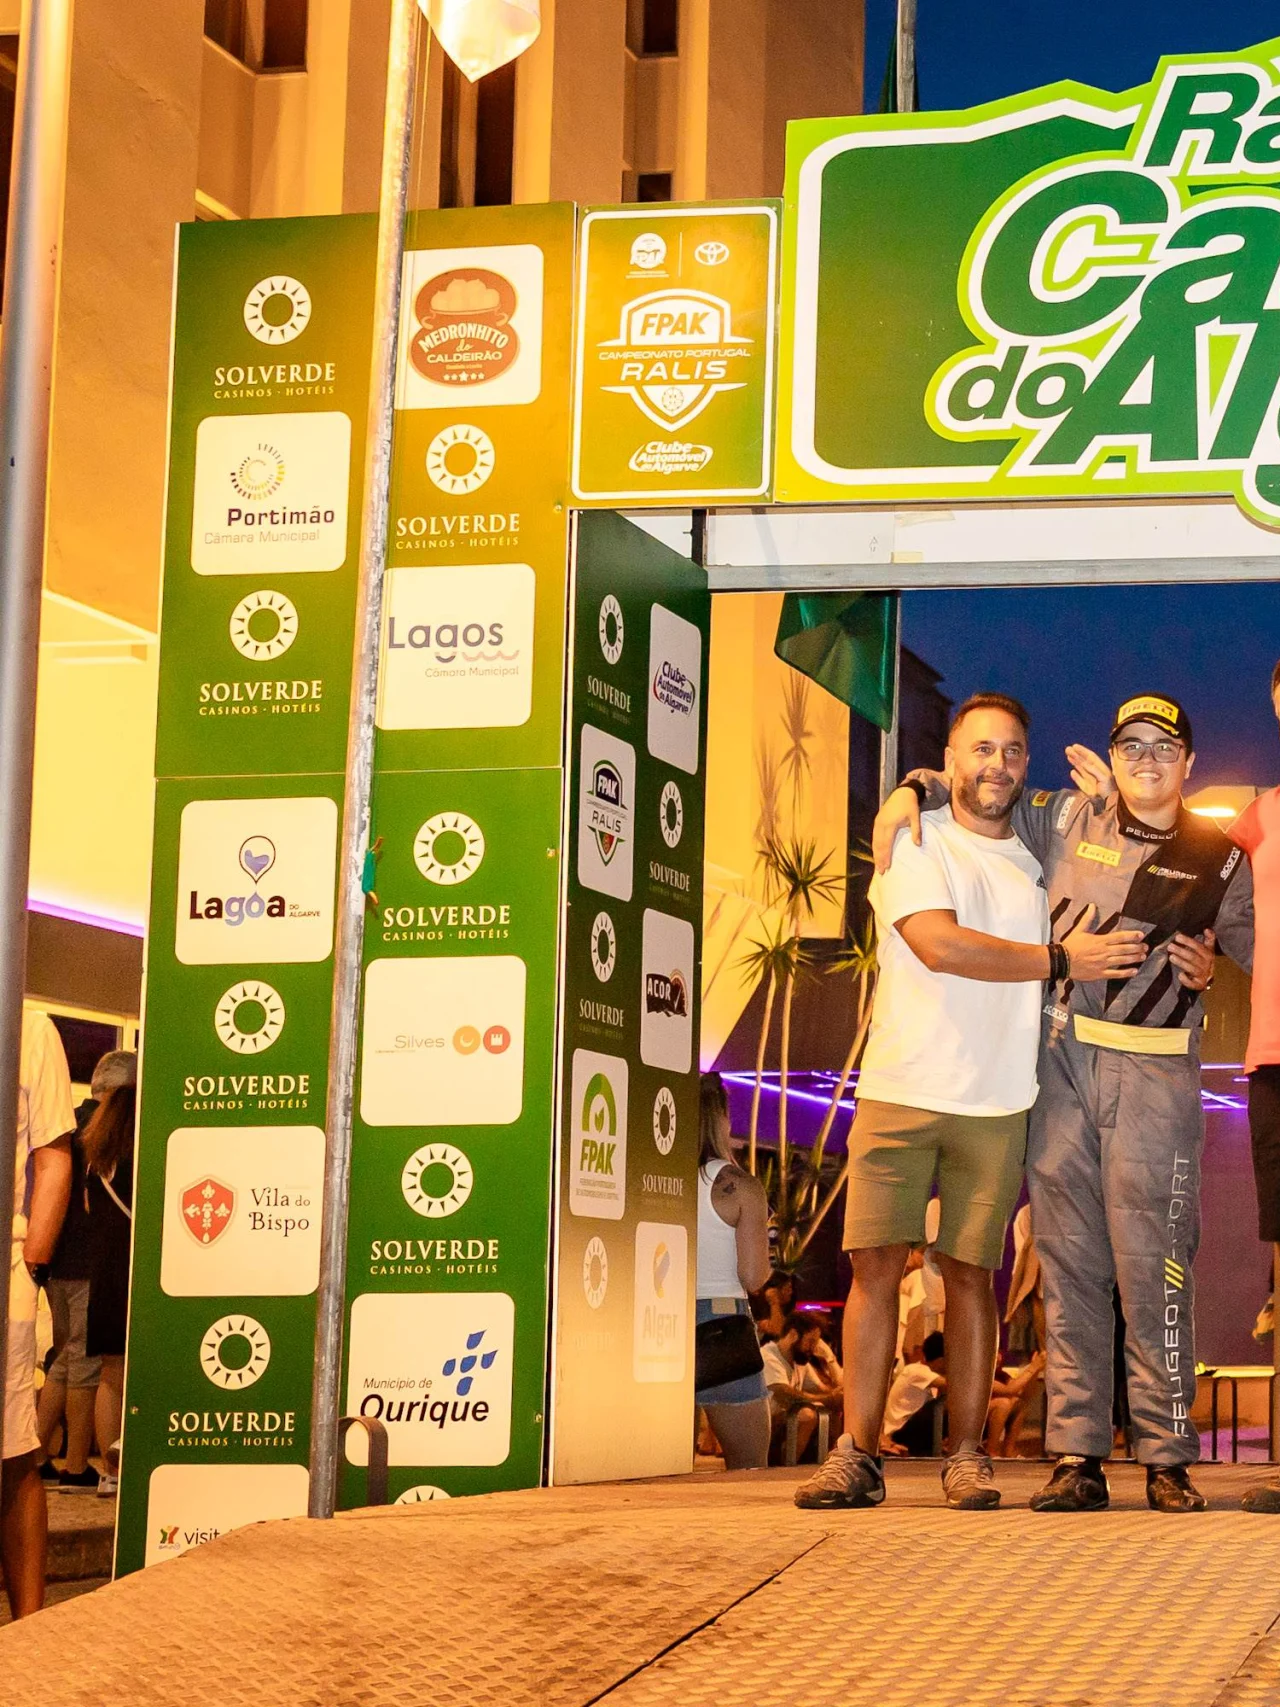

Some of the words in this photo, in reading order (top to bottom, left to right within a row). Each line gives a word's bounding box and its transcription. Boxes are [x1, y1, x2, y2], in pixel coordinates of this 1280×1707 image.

[639, 311, 711, 336] FPAK
[418, 322, 510, 353] MEDRONHITO
[426, 350, 503, 363] CALDEIRÃO
[599, 349, 684, 361] CAMPEONATO
[685, 347, 751, 358] PORTUGAL
[214, 363, 336, 386] SOLVERDE
[620, 360, 727, 381] RALIS
[214, 387, 272, 399] CASINOS
[283, 384, 335, 397] HOTÉIS
[947, 346, 1087, 422] do
[645, 440, 693, 454] Clube
[653, 461, 700, 475] Algarve
[227, 505, 336, 527] Portimão
[396, 513, 520, 537] SOLVERDE
[204, 532, 254, 545] Câmara
[258, 529, 320, 545] Municipal
[395, 539, 456, 550] CASINOS
[467, 535, 520, 548] HOTÉIS
[388, 615, 504, 663] Lagos
[425, 666, 465, 679] Câmara
[468, 665, 520, 679] Municipal
[199, 680, 323, 702] SOLVERDE
[587, 675, 631, 713] SOLVERDE
[199, 705, 258, 716] CASINOS
[271, 702, 322, 714] HOTÉIS
[597, 774, 618, 800] FPAK
[592, 810, 622, 834] RALIS
[649, 861, 691, 892] SOLVERDE
[189, 890, 285, 926] Lagoa
[383, 905, 511, 928] SOLVERDE
[383, 931, 444, 941] CASINOS
[458, 928, 509, 940] HOTÉIS
[647, 977, 672, 1001] ACOR
[579, 998, 624, 1027] SOLVERDE
[394, 1034, 445, 1049] Silves
[184, 1074, 310, 1097] SOLVERDE
[183, 1100, 244, 1111] CASINOS
[257, 1097, 308, 1109] HOTÉIS
[580, 1138, 616, 1175] FPAK
[642, 1173, 684, 1197] SOLVERDE
[251, 1187, 290, 1207] Vila
[295, 1196, 311, 1207] do
[1168, 1151, 1190, 1259] PORT
[249, 1211, 310, 1237] Bispo
[370, 1239, 499, 1261] SOLVERDE
[370, 1265, 432, 1275] CASINOS
[446, 1262, 498, 1274] HOTÉIS
[643, 1305, 678, 1346] Algar
[1163, 1282, 1189, 1438] PEUGEOT
[418, 1378, 433, 1390] de
[360, 1393, 490, 1429] Ourique
[168, 1412, 295, 1433] SOLVERDE
[168, 1437, 229, 1447] CASINOS
[242, 1434, 294, 1447] HOTÉIS
[184, 1528, 220, 1545] visit
